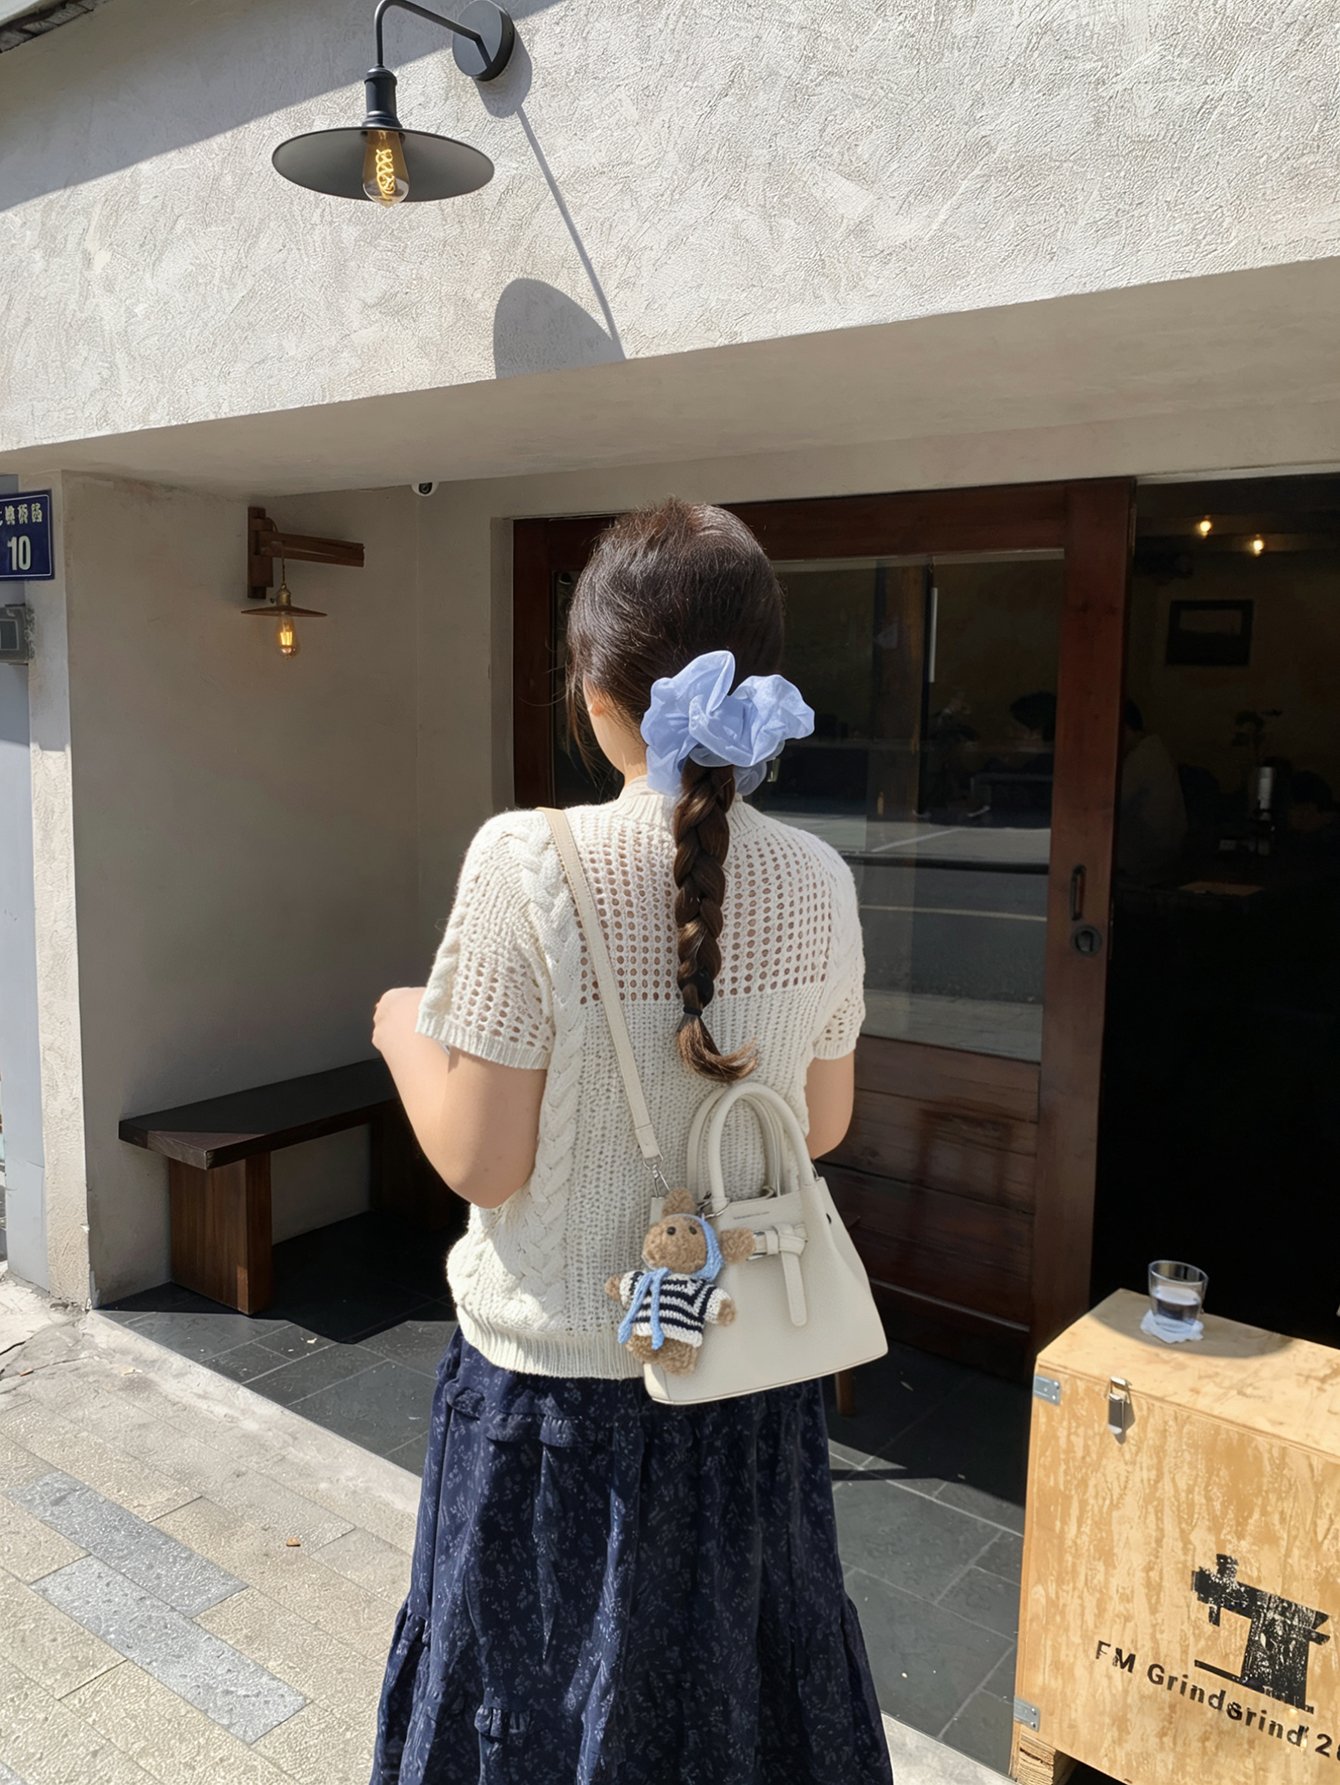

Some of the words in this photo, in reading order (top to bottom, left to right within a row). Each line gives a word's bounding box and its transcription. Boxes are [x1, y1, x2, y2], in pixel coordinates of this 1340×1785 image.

[7, 535, 31, 571] 10
[1095, 1640, 1136, 1674] FM
[1315, 1733, 1340, 1761] 2
